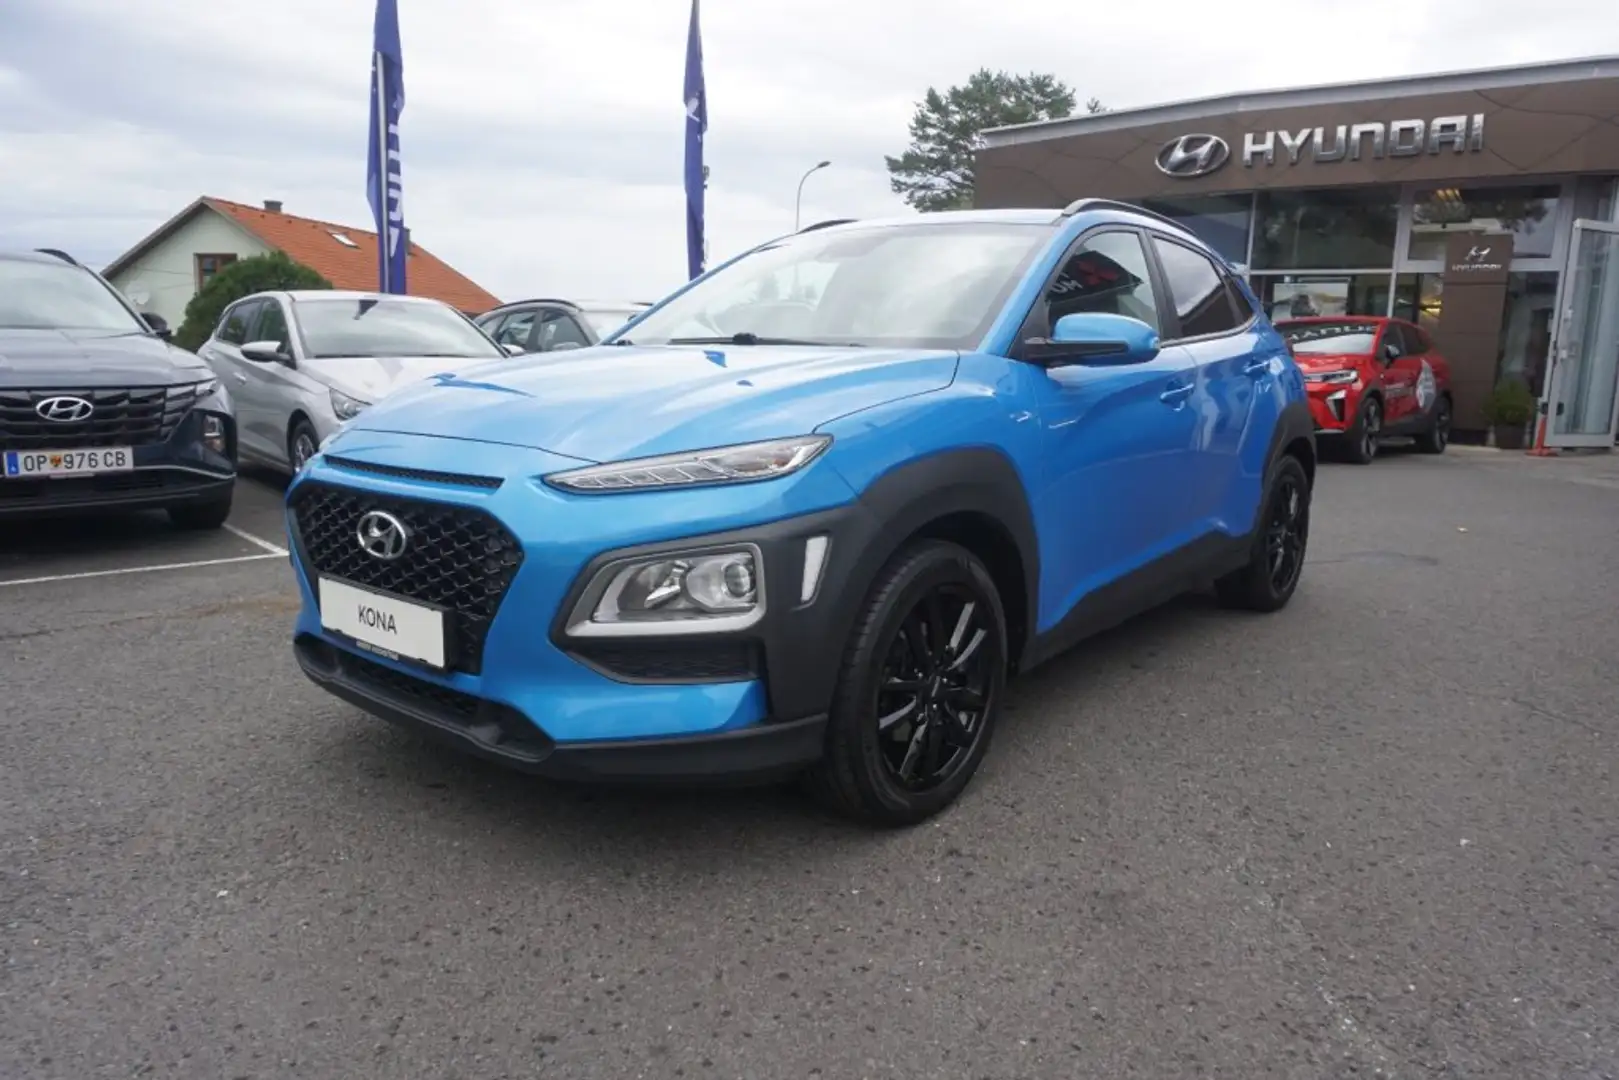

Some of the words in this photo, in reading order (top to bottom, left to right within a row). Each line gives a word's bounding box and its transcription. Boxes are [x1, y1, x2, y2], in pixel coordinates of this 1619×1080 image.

[1242, 113, 1485, 167] HYUNDAI
[23, 455, 47, 472] OP
[63, 452, 98, 470] 976
[103, 451, 126, 468] CB
[358, 605, 398, 634] KONA
